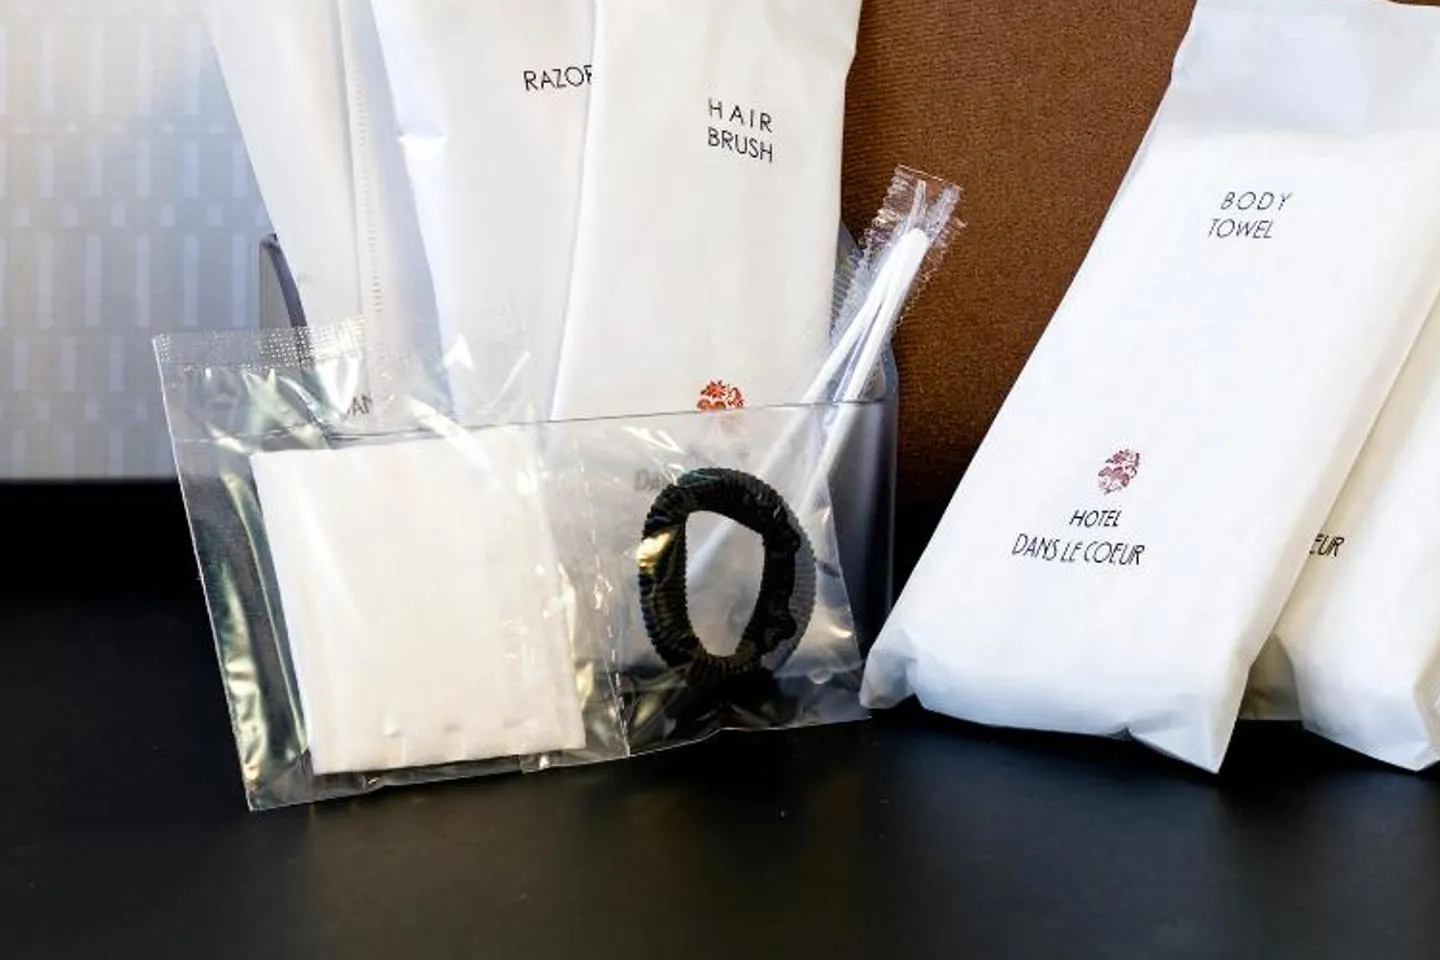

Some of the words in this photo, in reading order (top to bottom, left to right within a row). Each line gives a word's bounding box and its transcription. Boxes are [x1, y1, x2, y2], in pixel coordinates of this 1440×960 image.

[707, 97, 773, 133] HAIR
[707, 126, 773, 163] BRUSH
[1220, 191, 1293, 211] BODY
[1207, 218, 1274, 239] TOWEL
[1068, 509, 1122, 528] HOTEL
[1011, 532, 1060, 561] DANS
[1060, 542, 1083, 562] LE
[1084, 541, 1145, 565] COEUR
[1309, 533, 1345, 558] EUR
